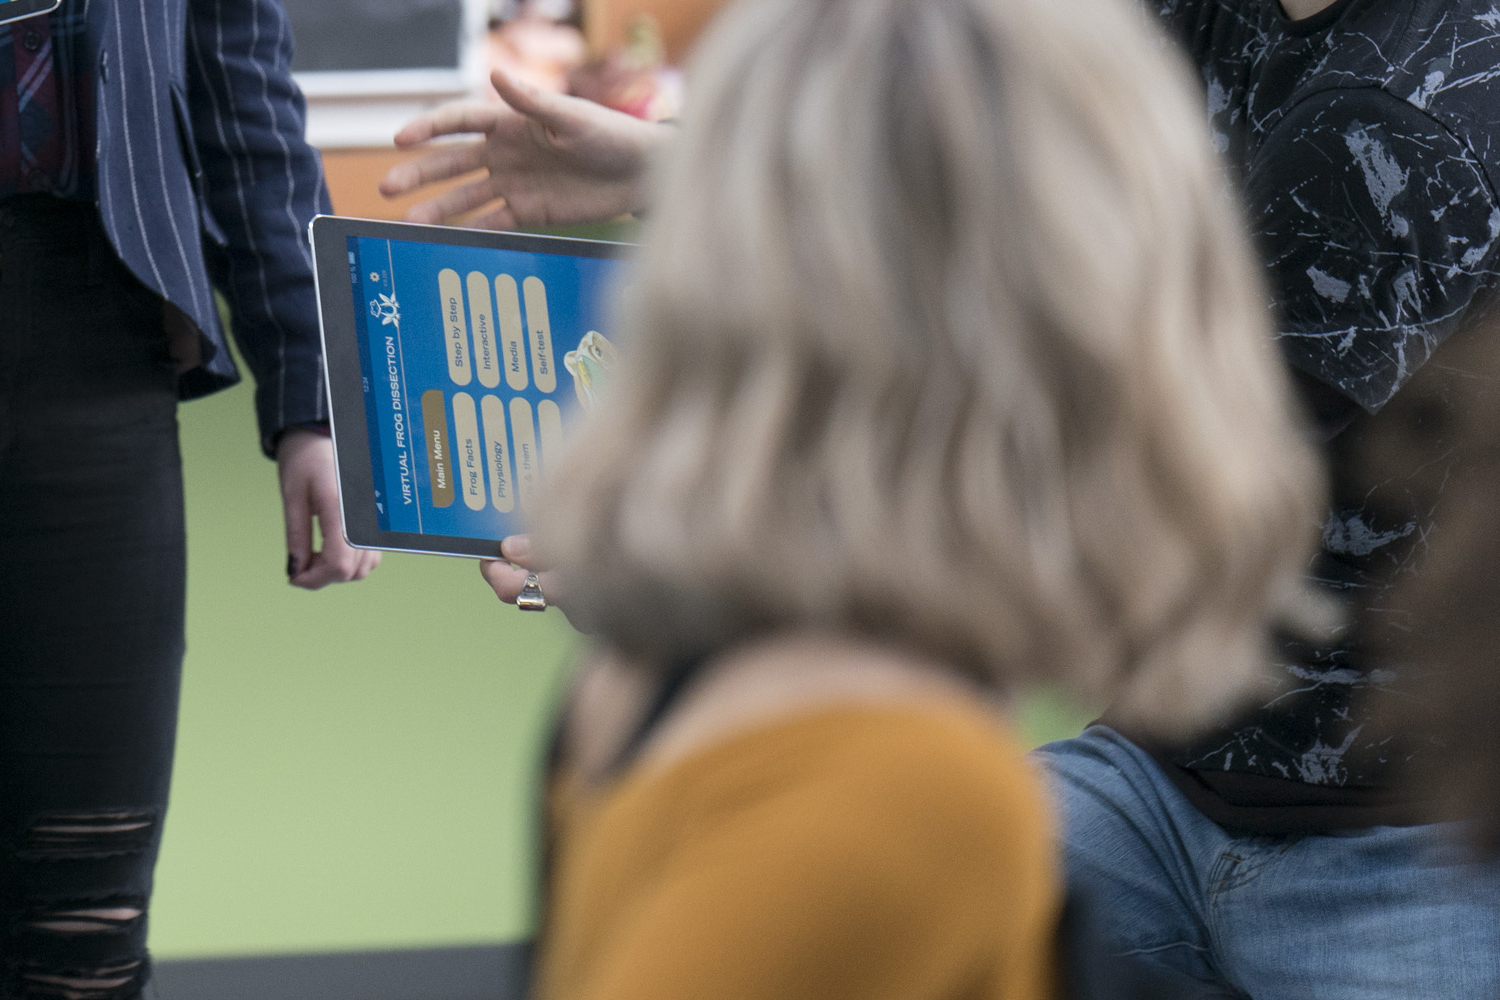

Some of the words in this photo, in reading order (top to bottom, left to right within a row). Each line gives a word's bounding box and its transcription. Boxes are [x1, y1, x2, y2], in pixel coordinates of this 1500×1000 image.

[449, 297, 458, 323] Step
[452, 325, 461, 339] by
[478, 313, 492, 370] Interactive
[454, 341, 464, 368] Step
[509, 340, 520, 373] Media
[536, 329, 549, 375] Self-test
[385, 336, 402, 410] DISSECTION
[393, 413, 406, 448] FROG
[433, 429, 444, 460] Menu
[465, 438, 475, 468] Facts
[521, 443, 531, 470] them
[399, 450, 413, 505] VIRTUAL
[435, 462, 446, 489] Main
[469, 471, 478, 496] Frog
[493, 441, 507, 499] Physiology
